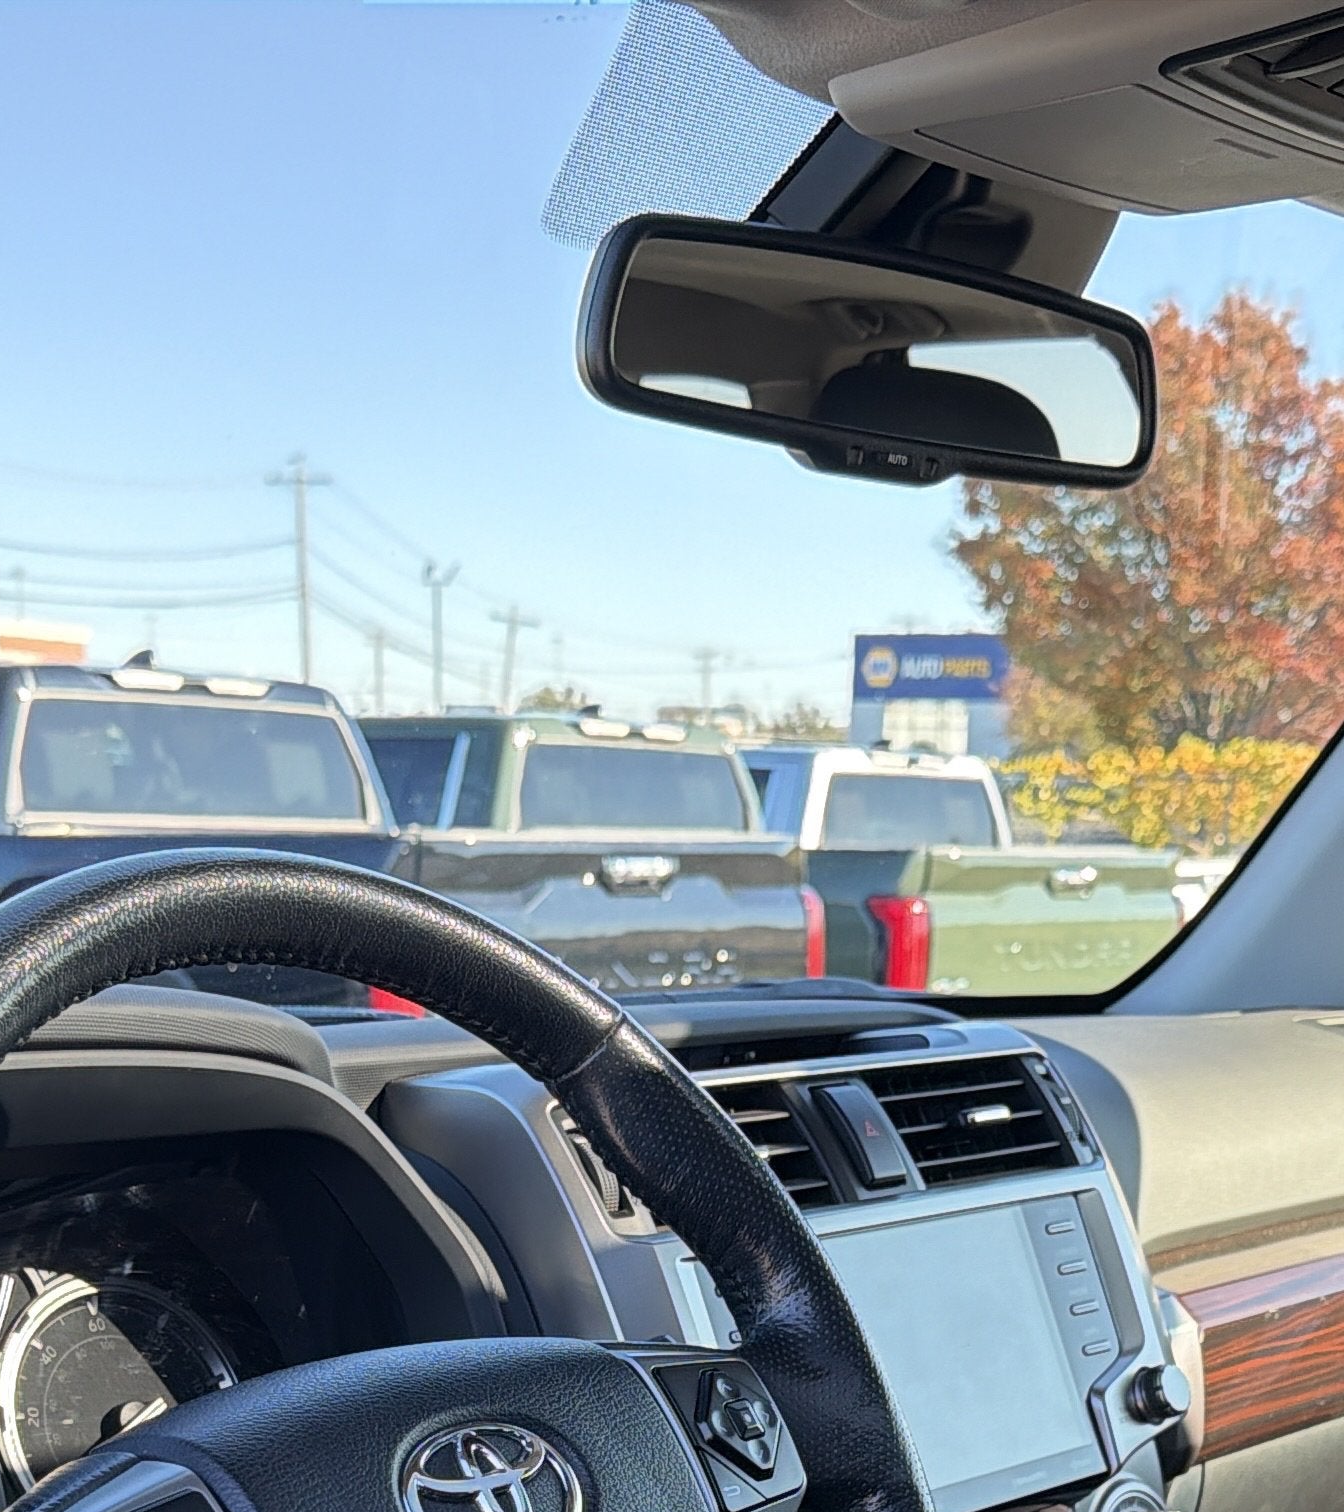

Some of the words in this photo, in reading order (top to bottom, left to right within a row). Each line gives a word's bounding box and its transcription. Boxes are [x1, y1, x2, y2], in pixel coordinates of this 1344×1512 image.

[887, 453, 908, 466] AUTO
[88, 1318, 106, 1333] 60
[40, 1345, 58, 1365] 40
[27, 1406, 40, 1428] 20
